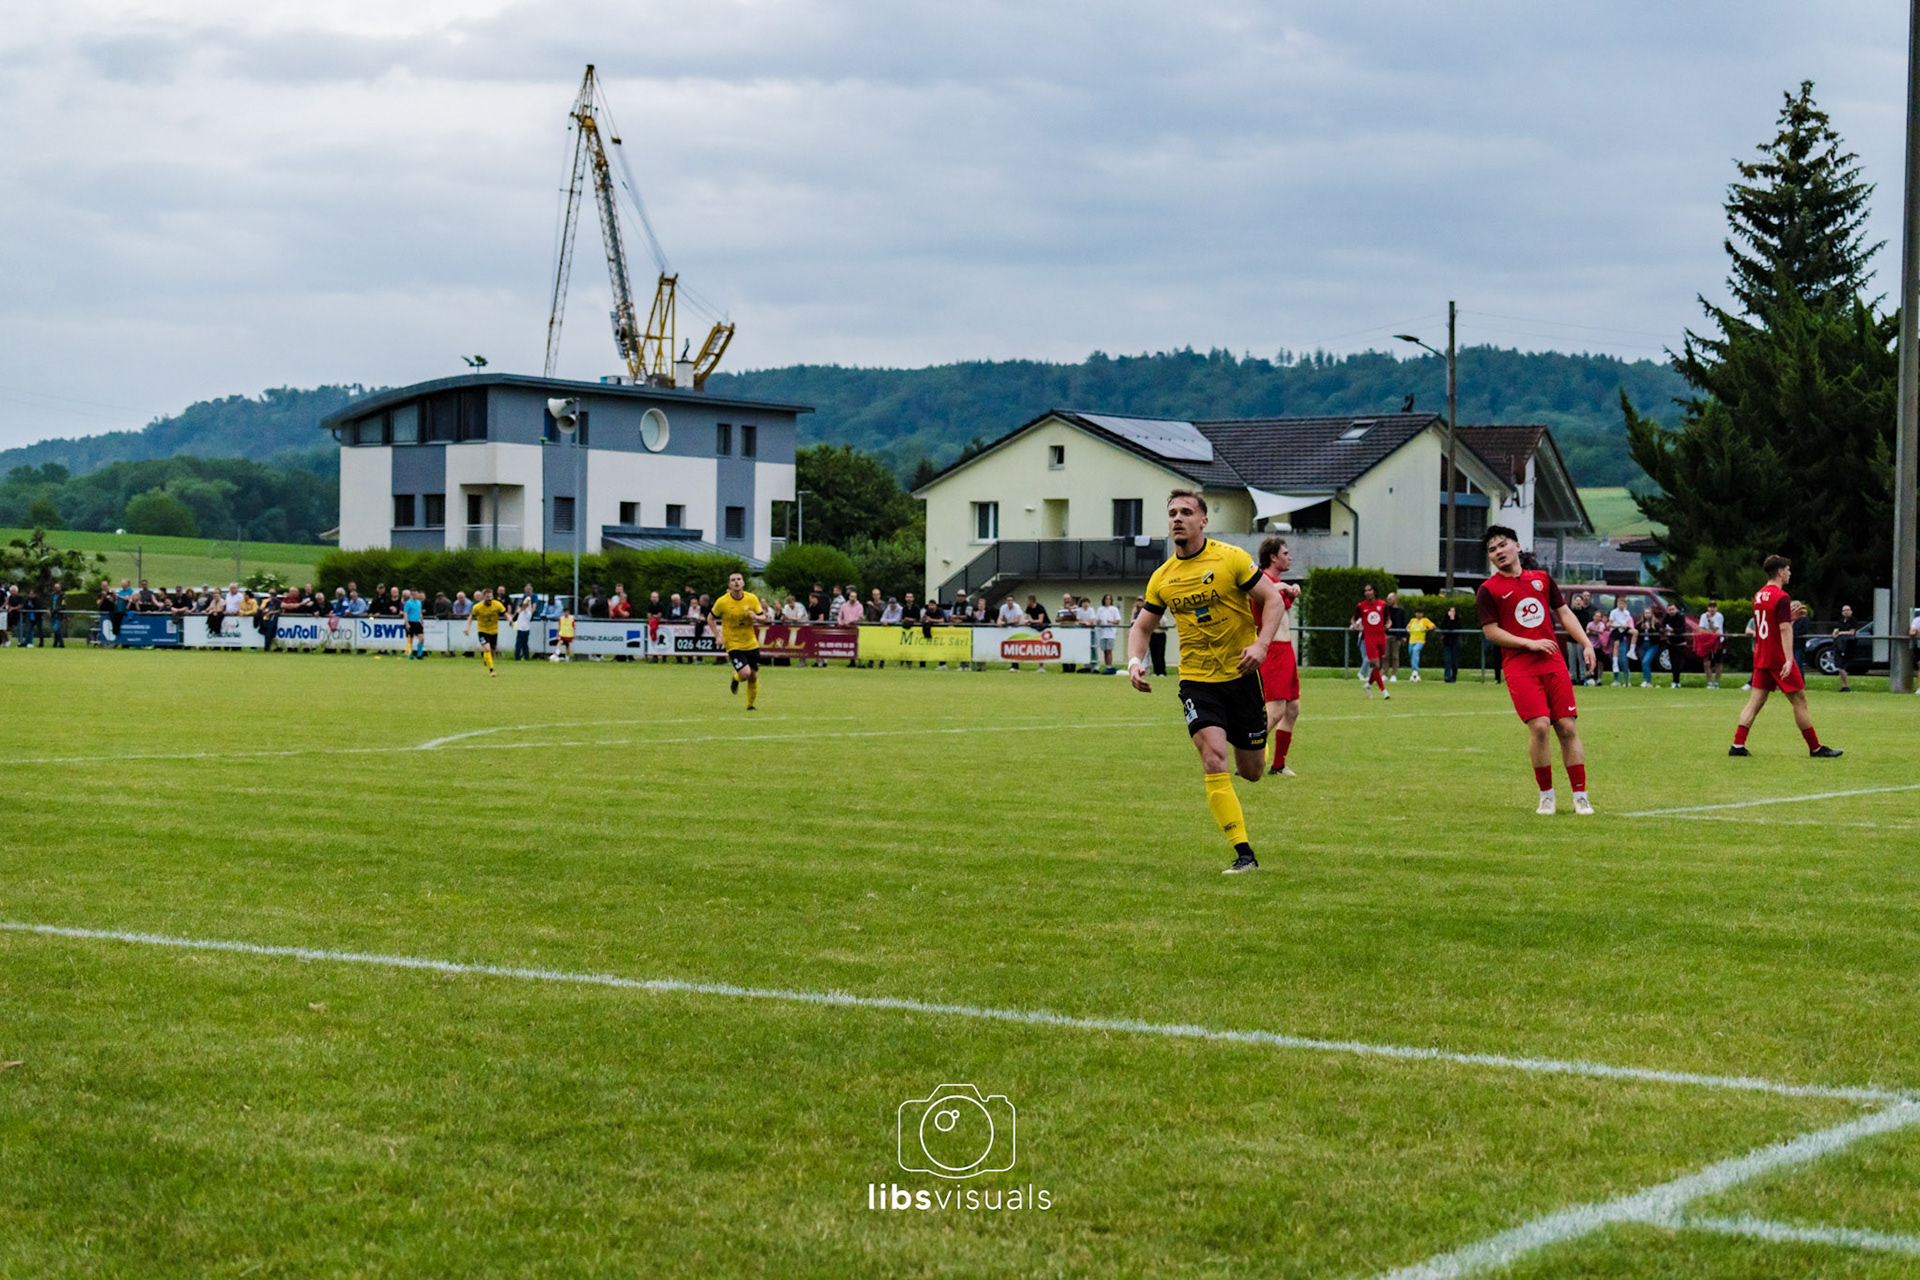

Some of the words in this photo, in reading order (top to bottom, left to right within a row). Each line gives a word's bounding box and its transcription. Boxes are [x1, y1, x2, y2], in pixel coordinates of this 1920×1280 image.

[1172, 589, 1220, 611] PADEA
[276, 624, 317, 639] onRoll
[373, 623, 405, 639] BWT
[1754, 609, 1769, 640] 16
[677, 639, 694, 650] 026
[695, 639, 713, 650] 422
[1003, 644, 1060, 657] MICARNA
